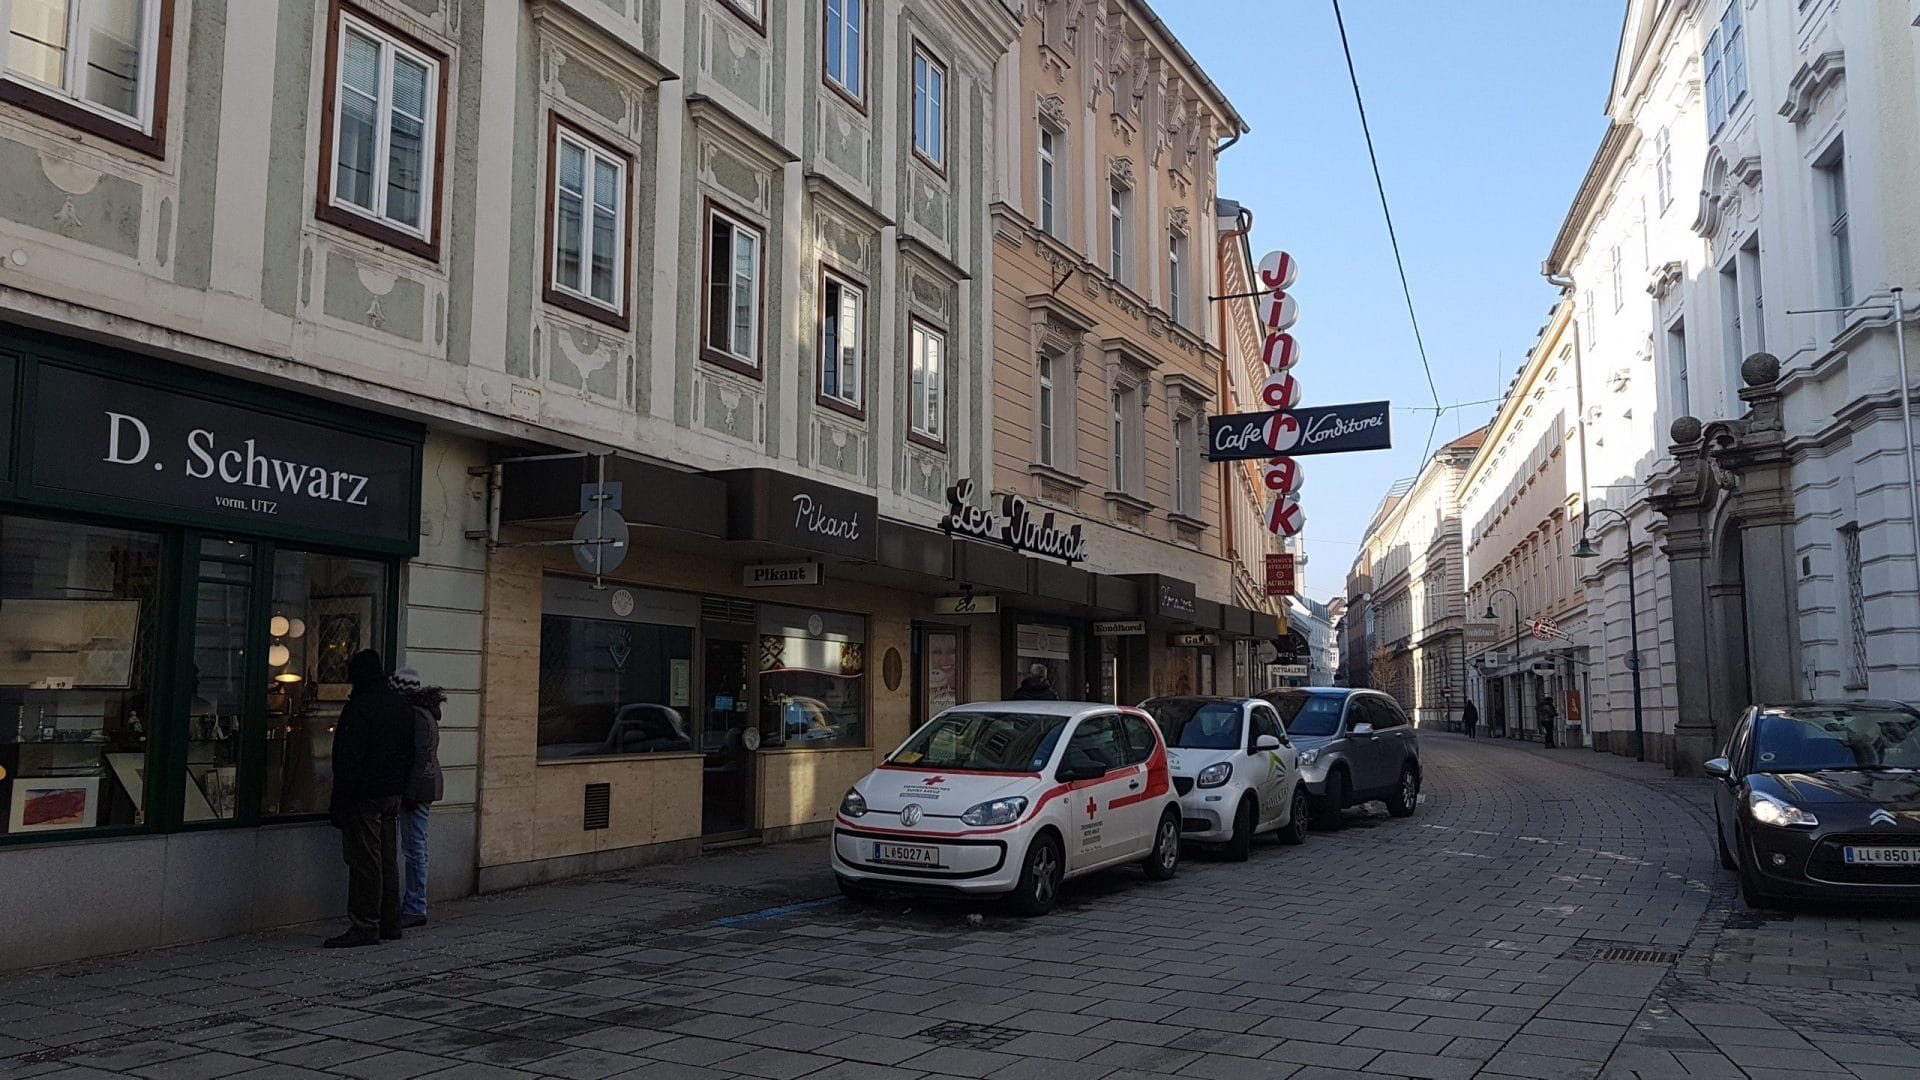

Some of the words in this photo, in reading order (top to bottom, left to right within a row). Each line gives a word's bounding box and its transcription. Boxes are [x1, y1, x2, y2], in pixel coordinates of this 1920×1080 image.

[1262, 252, 1300, 536] Jindrak
[1301, 412, 1384, 447] Konditorei
[102, 411, 163, 471] D.
[186, 428, 369, 506] Schwarz
[215, 495, 248, 511] vorm.
[252, 499, 279, 515] UTZ
[792, 493, 859, 541] Pikant
[951, 478, 994, 535] Leo
[1007, 494, 1089, 562] Jindrak
[753, 567, 806, 582] Pikant
[1096, 623, 1142, 633] Konditorei
[885, 846, 890, 858] L
[897, 847, 922, 860] 5027
[924, 850, 931, 862] A
[1858, 849, 1874, 861] LL
[1883, 849, 1909, 862] 850
